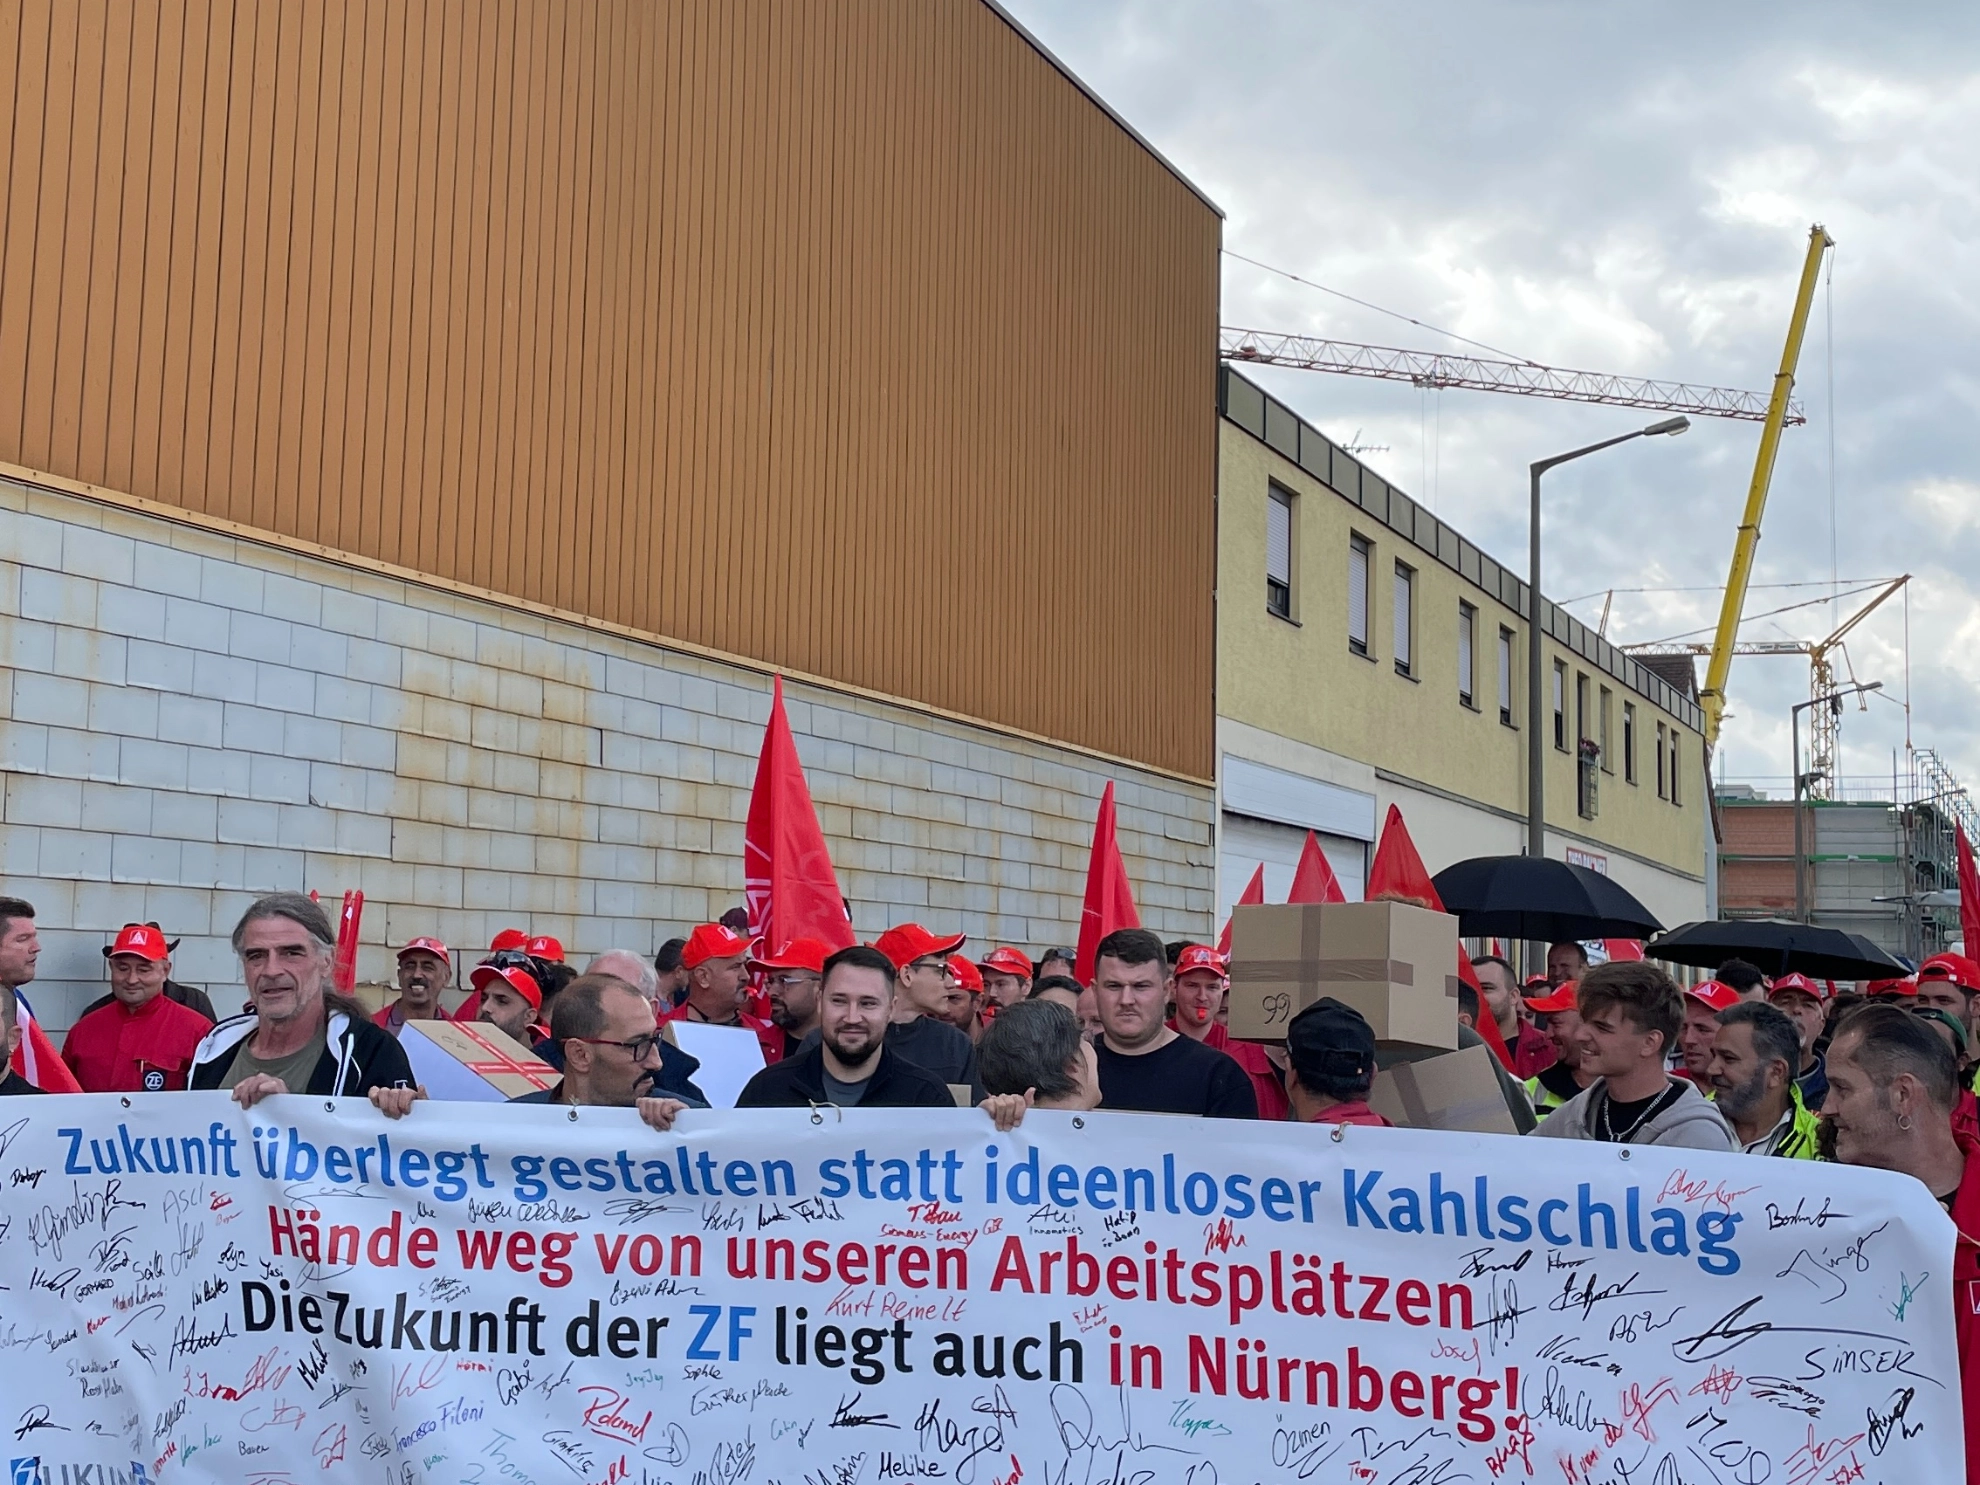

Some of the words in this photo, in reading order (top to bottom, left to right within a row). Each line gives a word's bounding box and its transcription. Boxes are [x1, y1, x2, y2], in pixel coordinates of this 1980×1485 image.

[1263, 993, 1290, 1024] 99
[147, 1076, 161, 1085] ZF
[57, 1122, 240, 1176] Zukunft
[253, 1126, 496, 1201] überlegt
[510, 1145, 797, 1203] gestalten
[819, 1148, 963, 1203] statt
[985, 1145, 1321, 1224] ideenloser
[1343, 1169, 1743, 1277] Kahlschlag
[269, 1204, 438, 1270] Hände
[456, 1229, 578, 1288] weg
[594, 1232, 701, 1276] von
[726, 1235, 968, 1290] unseren
[990, 1235, 1473, 1331] Arbeitsplätzen
[241, 1279, 325, 1333] Die
[326, 1295, 545, 1355] Zukunft
[566, 1300, 668, 1359] der
[686, 1304, 756, 1361] ZF
[775, 1305, 913, 1385] liegt
[933, 1321, 1083, 1383] auch
[1109, 1324, 1162, 1390] in
[1188, 1333, 1519, 1442] Nürnberg!
[878, 1452, 947, 1480] Melike
